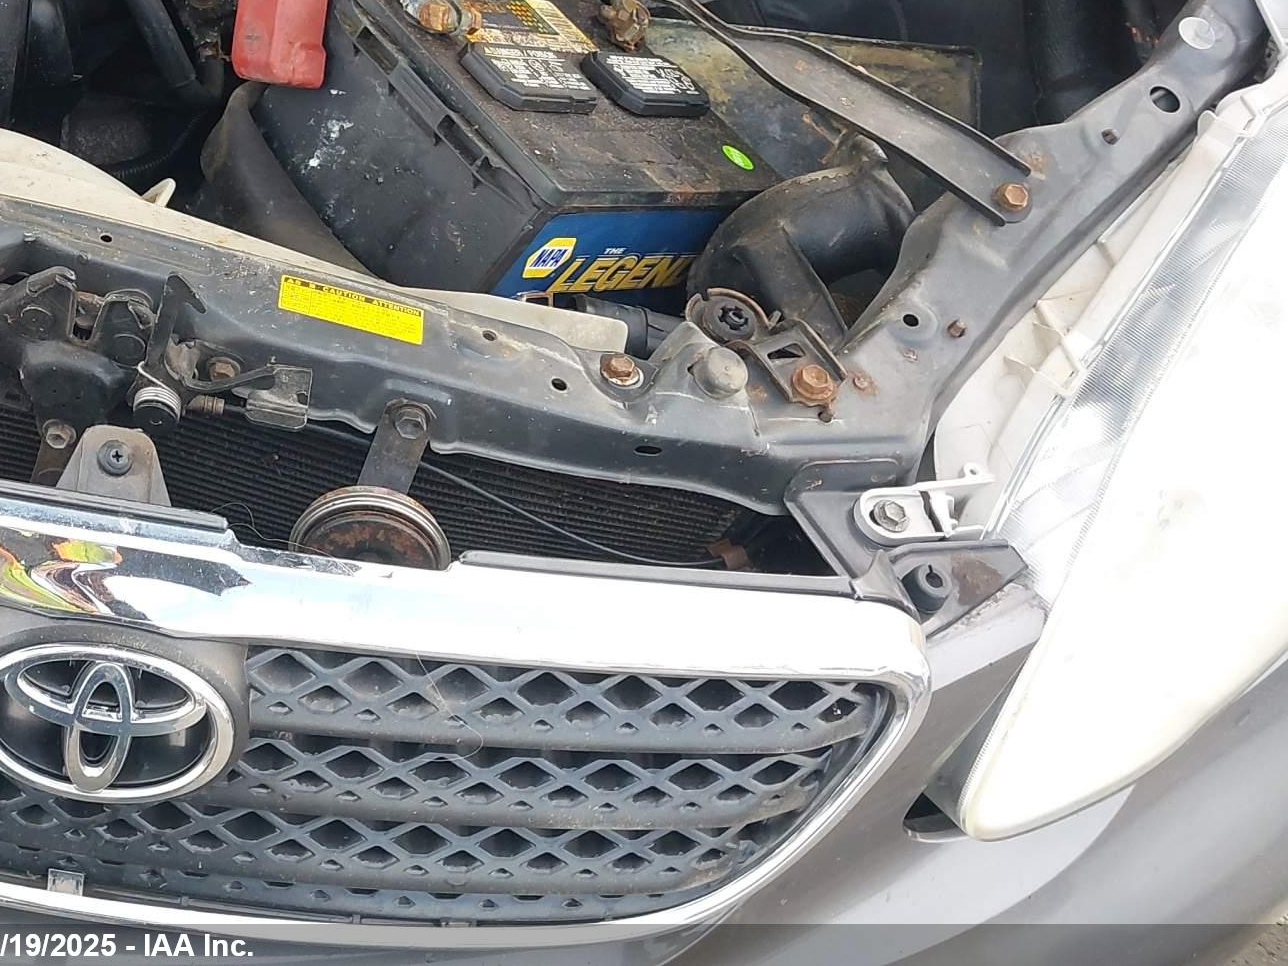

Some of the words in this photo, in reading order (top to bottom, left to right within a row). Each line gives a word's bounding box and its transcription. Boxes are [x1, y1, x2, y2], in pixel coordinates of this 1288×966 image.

[528, 247, 569, 269] NAPA
[603, 247, 627, 255] THE
[322, 286, 367, 303] CAUTION
[372, 299, 420, 317] ATTENTION
